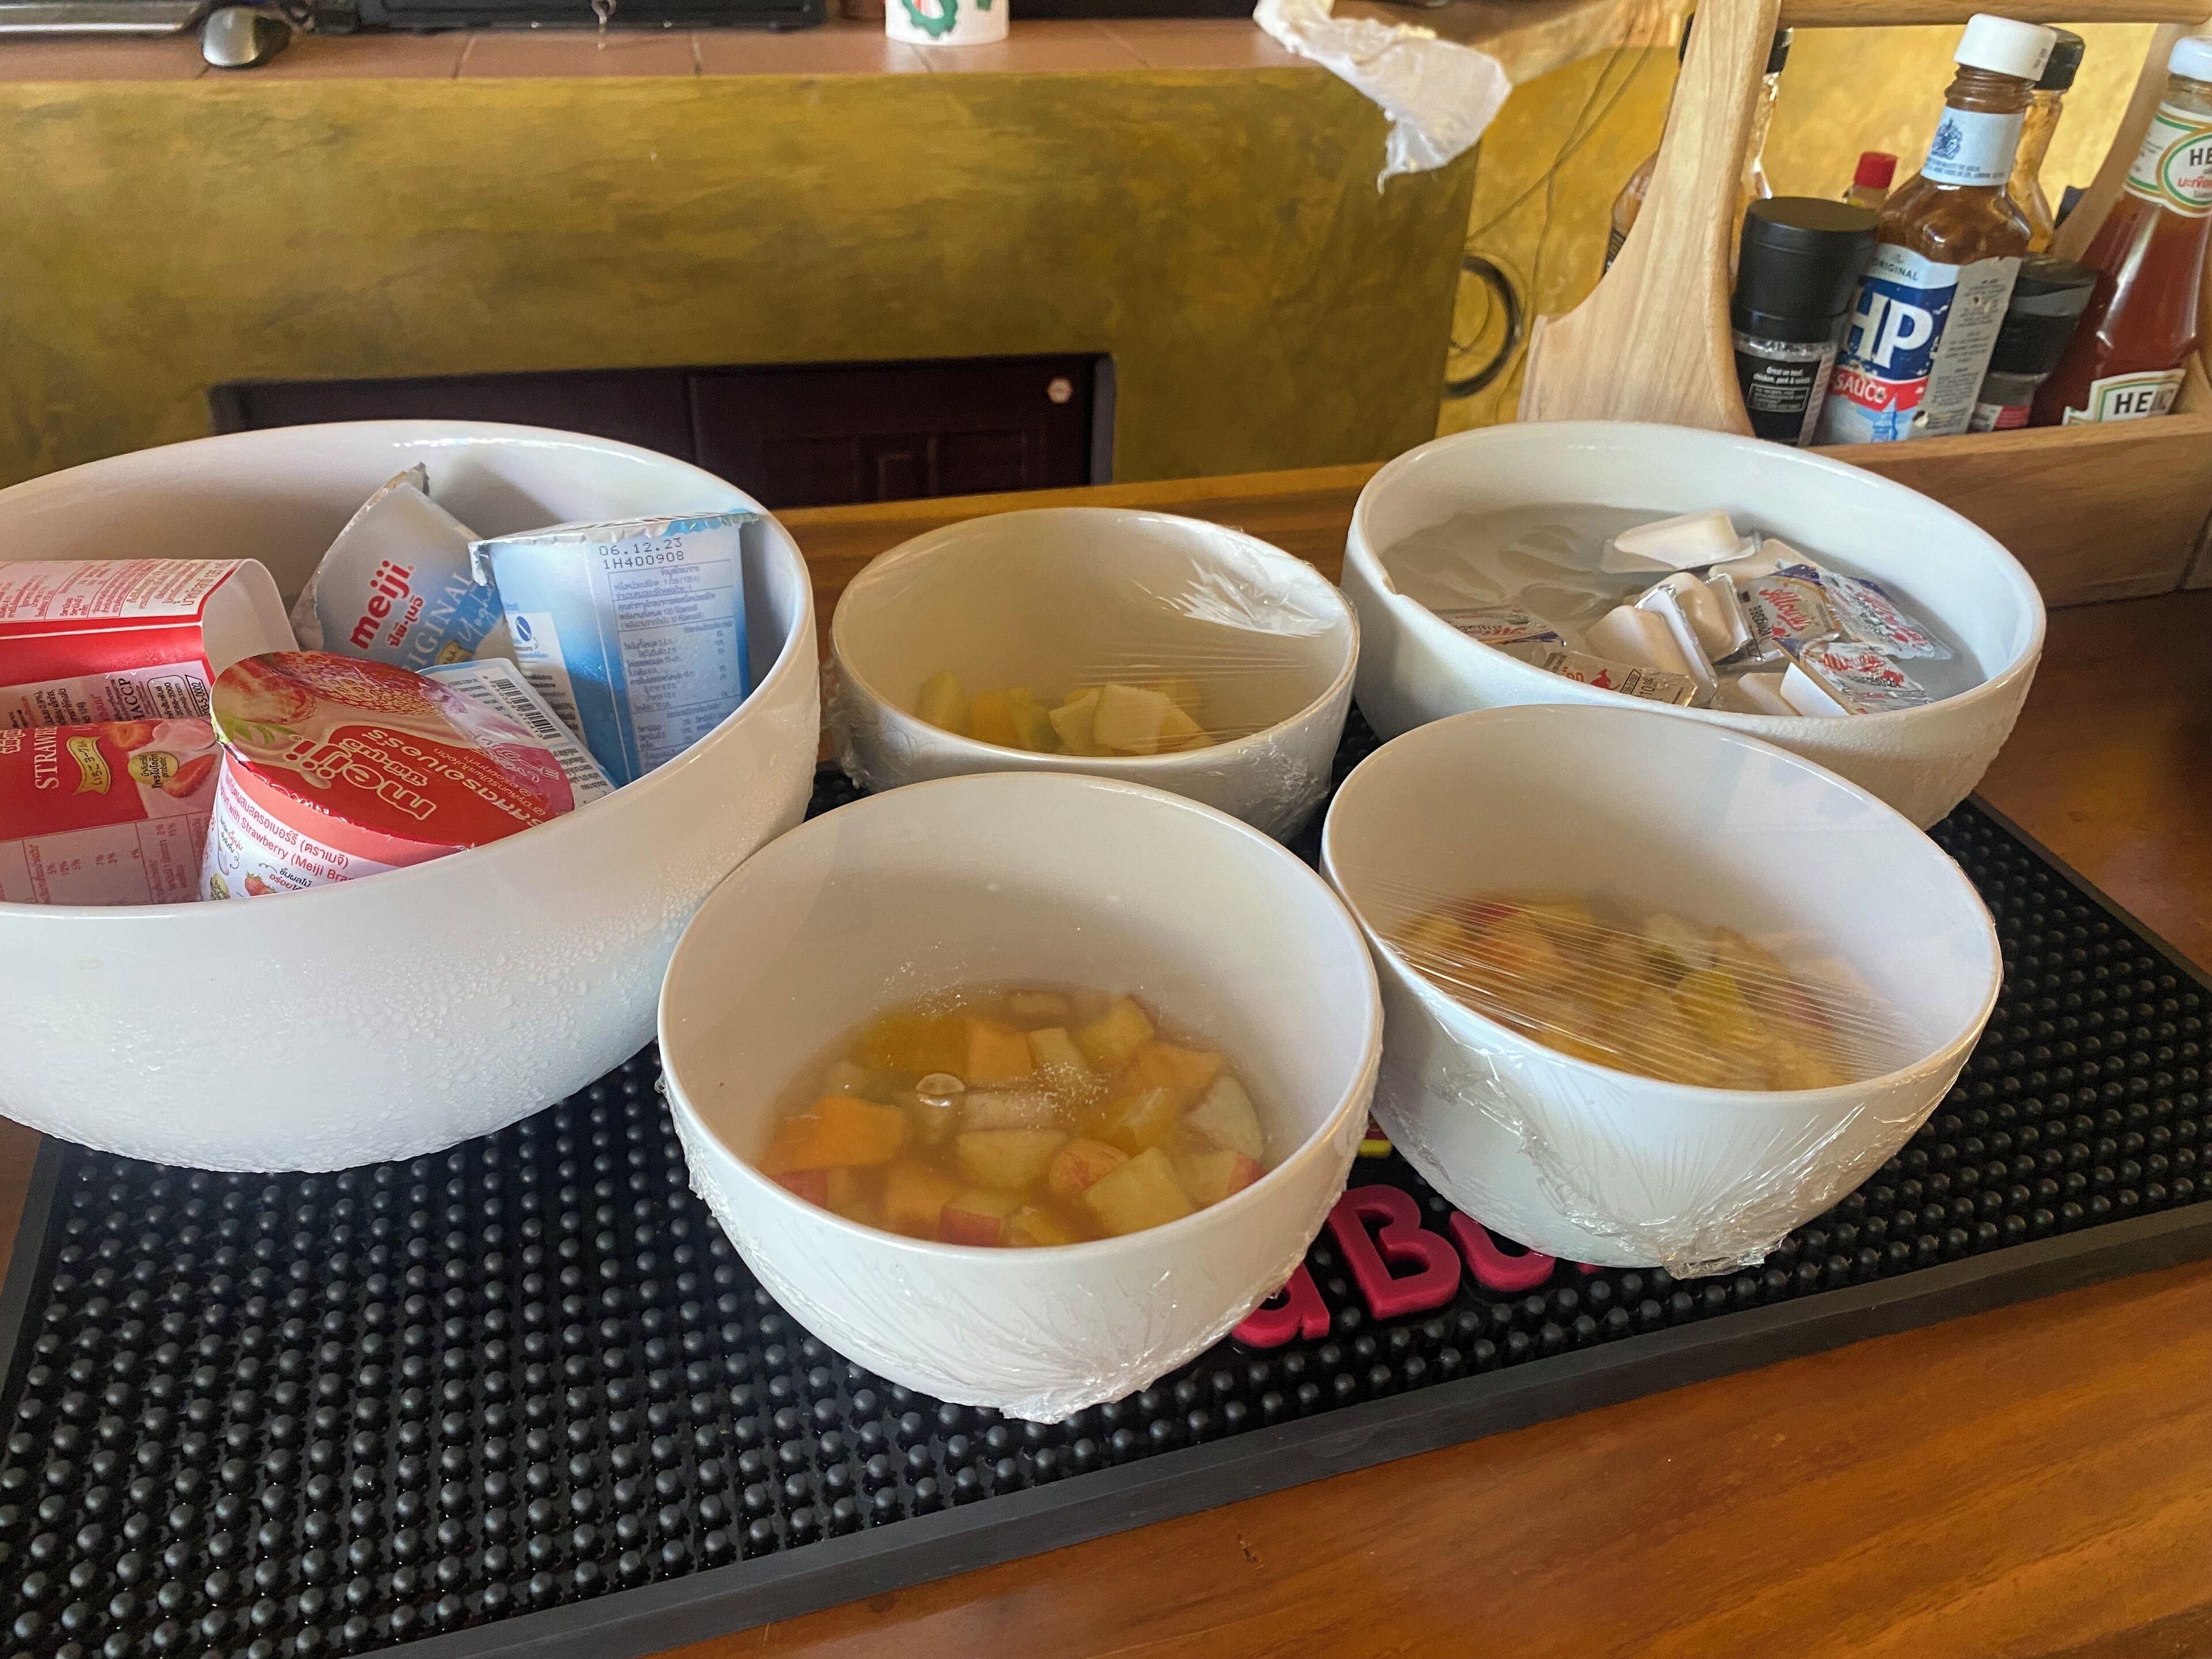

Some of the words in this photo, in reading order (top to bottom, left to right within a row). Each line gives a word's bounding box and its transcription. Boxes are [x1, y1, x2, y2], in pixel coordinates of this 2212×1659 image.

[1845, 291, 1933, 369] HP
[599, 537, 682, 556] 06.12.23
[603, 551, 684, 570] 1H400908
[349, 560, 411, 650] meiji
[404, 573, 474, 671] IGINAL
[33, 727, 59, 789] STRAWBE
[283, 739, 437, 820] meiji
[240, 817, 289, 859] Strawberry
[290, 853, 324, 877] (Meiji
[279, 867, 313, 888] ชิ้นผลไม้
[300, 840, 349, 869] (ตราเมจิ)
